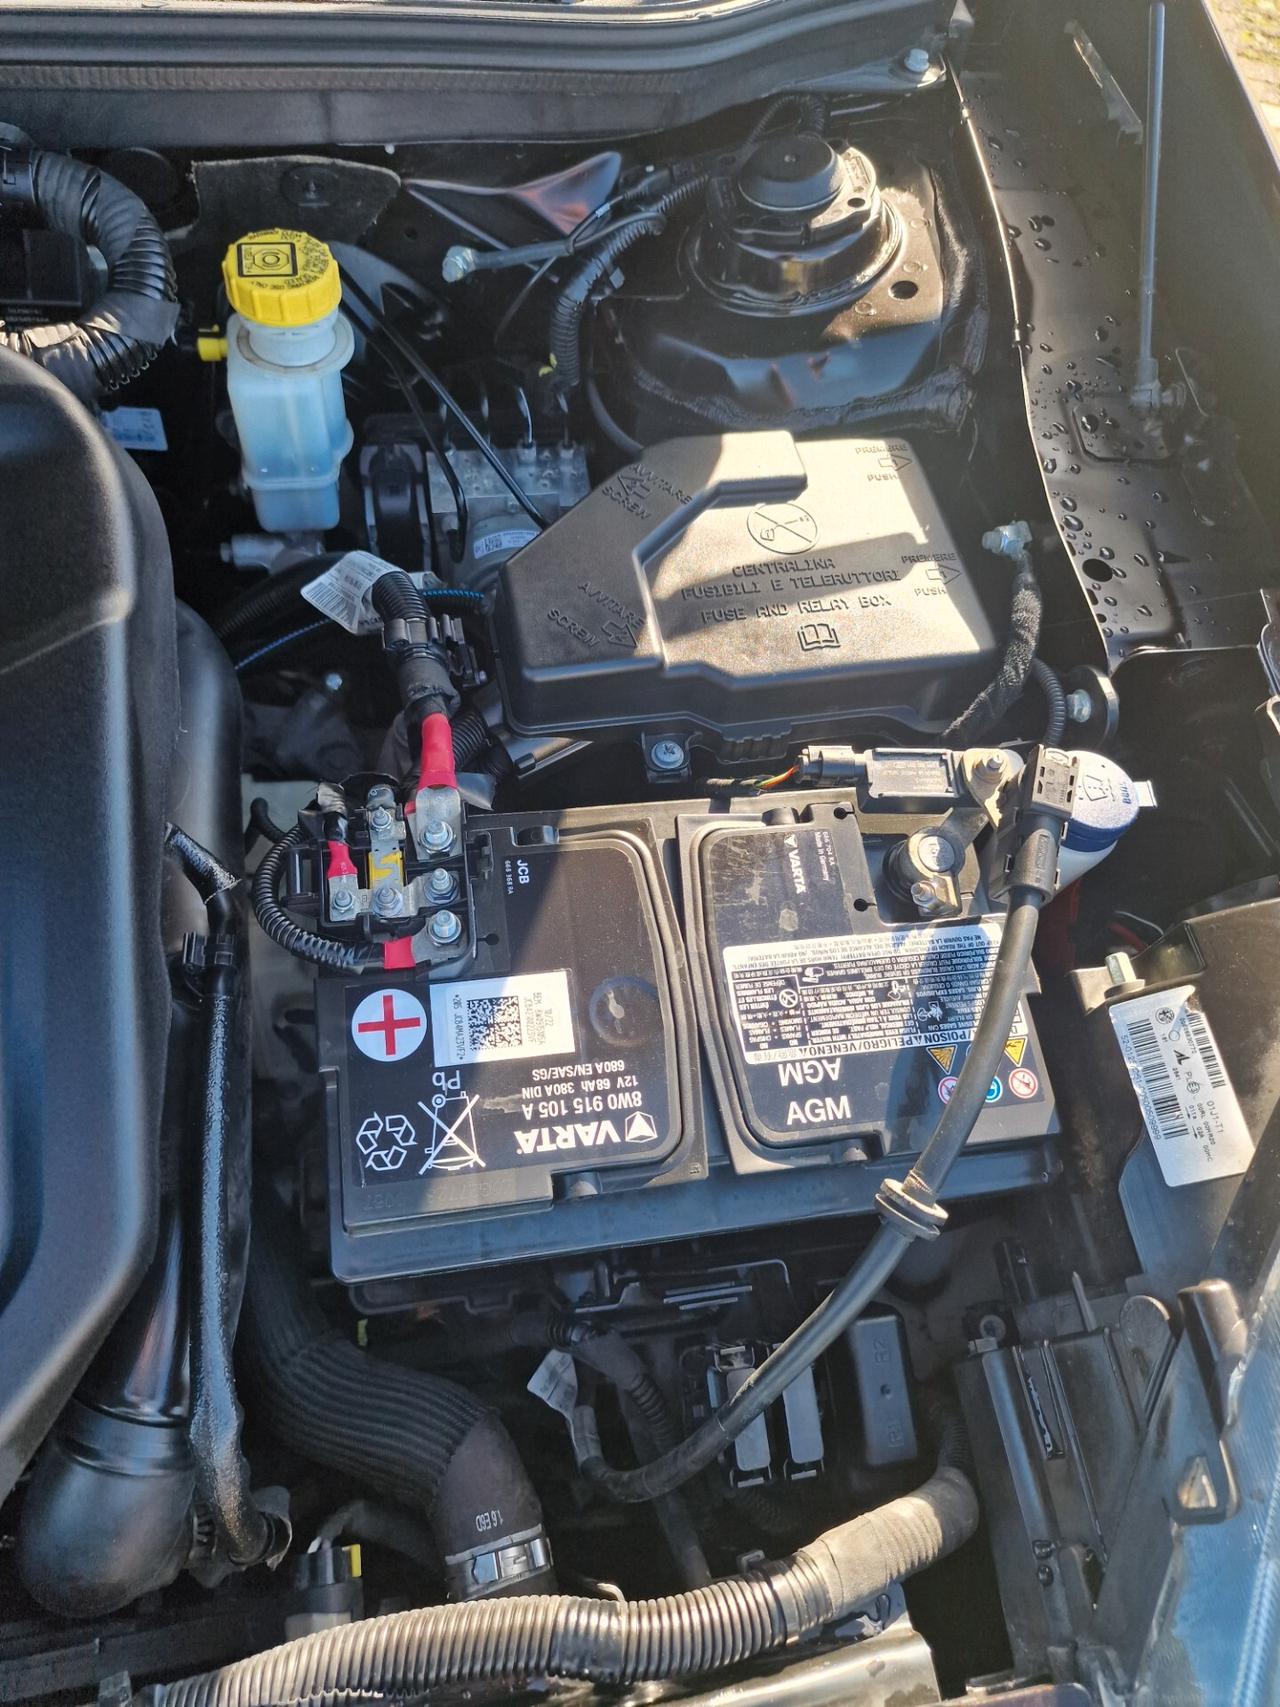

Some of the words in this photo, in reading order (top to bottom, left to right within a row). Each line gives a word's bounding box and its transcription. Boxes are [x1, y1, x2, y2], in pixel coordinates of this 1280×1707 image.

[601, 485, 651, 520] SCREW
[732, 558, 836, 577] CENTRALINA
[901, 552, 958, 564] PREMERE
[681, 581, 761, 600] FUSIBILI
[772, 579, 784, 591] E
[790, 570, 901, 590] TELERUTTORI
[701, 608, 746, 623] FUSE
[756, 603, 789, 617] AND
[800, 597, 850, 613] RELAY
[859, 594, 892, 608] BOX
[547, 608, 600, 648] SCREW
[516, 858, 529, 884] JCB
[787, 848, 806, 894] VARTA
[531, 1062, 592, 1080] EN/SAE/GS
[594, 1059, 624, 1073] 680A
[778, 1057, 842, 1086] AGM
[432, 1071, 461, 1096] Pb
[544, 1081, 574, 1096] 380A
[580, 1077, 610, 1092] 68Ah
[616, 1074, 638, 1088] 12V
[521, 1085, 542, 1098] DIN
[606, 1090, 642, 1110] 8W0
[521, 1102, 534, 1120] A
[537, 1099, 568, 1118] 105
[572, 1094, 603, 1114] 915
[786, 1095, 852, 1125] AGM
[513, 1118, 620, 1154] VARTA
